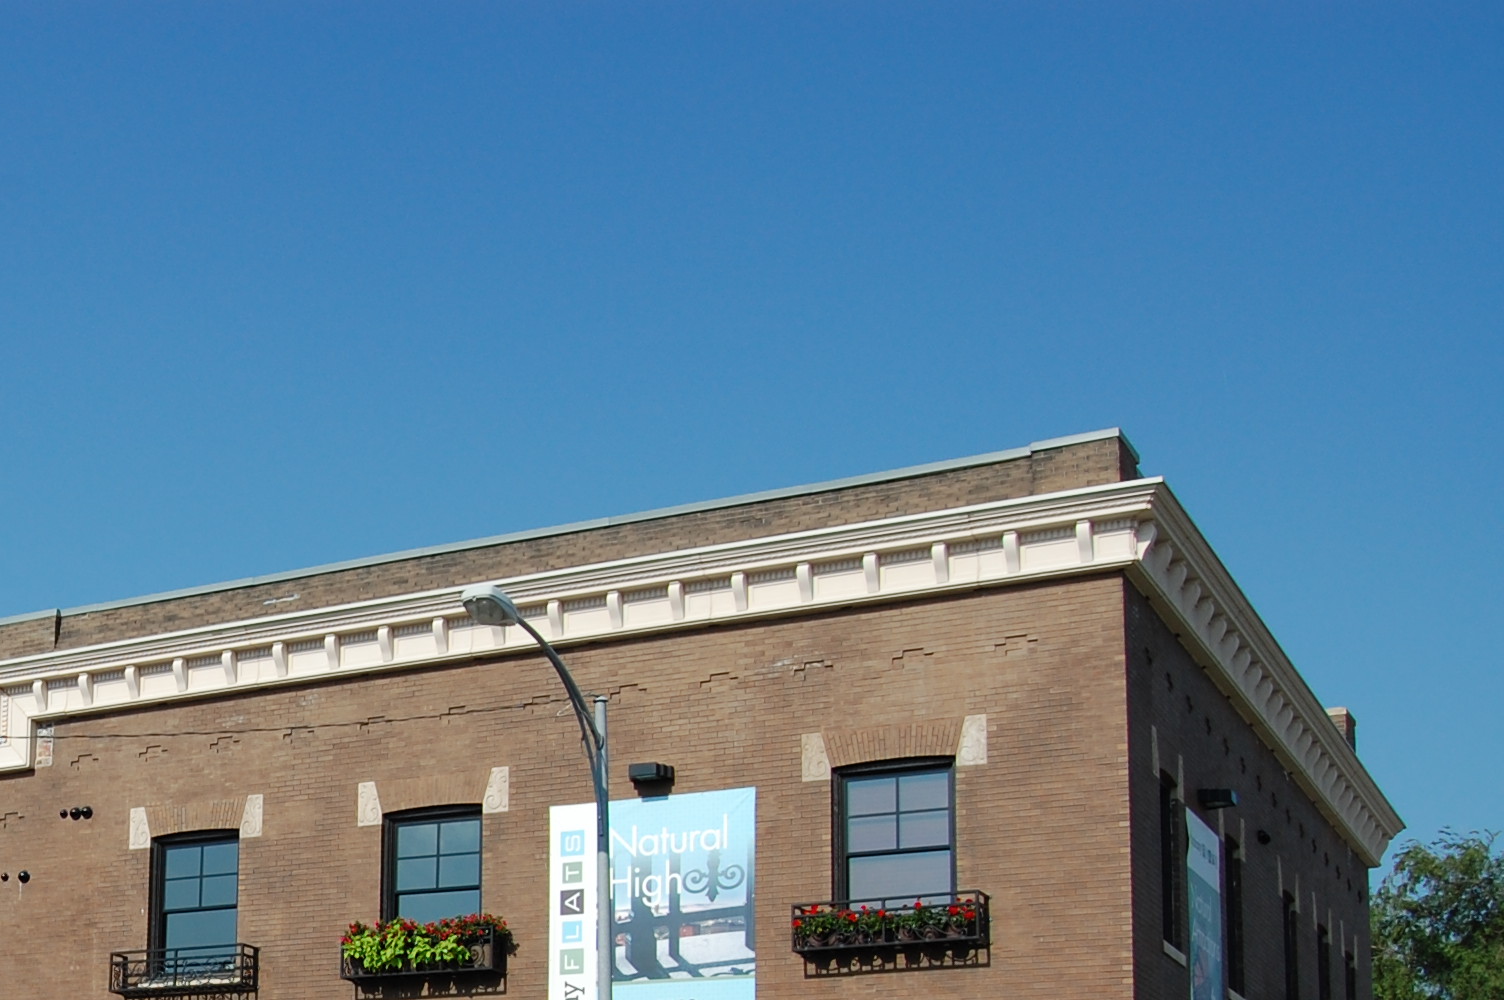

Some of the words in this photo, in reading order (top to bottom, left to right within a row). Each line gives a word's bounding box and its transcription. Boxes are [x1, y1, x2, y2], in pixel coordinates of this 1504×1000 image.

[609, 813, 728, 859] Natural
[561, 831, 584, 973] FLATS
[609, 859, 682, 911] High
